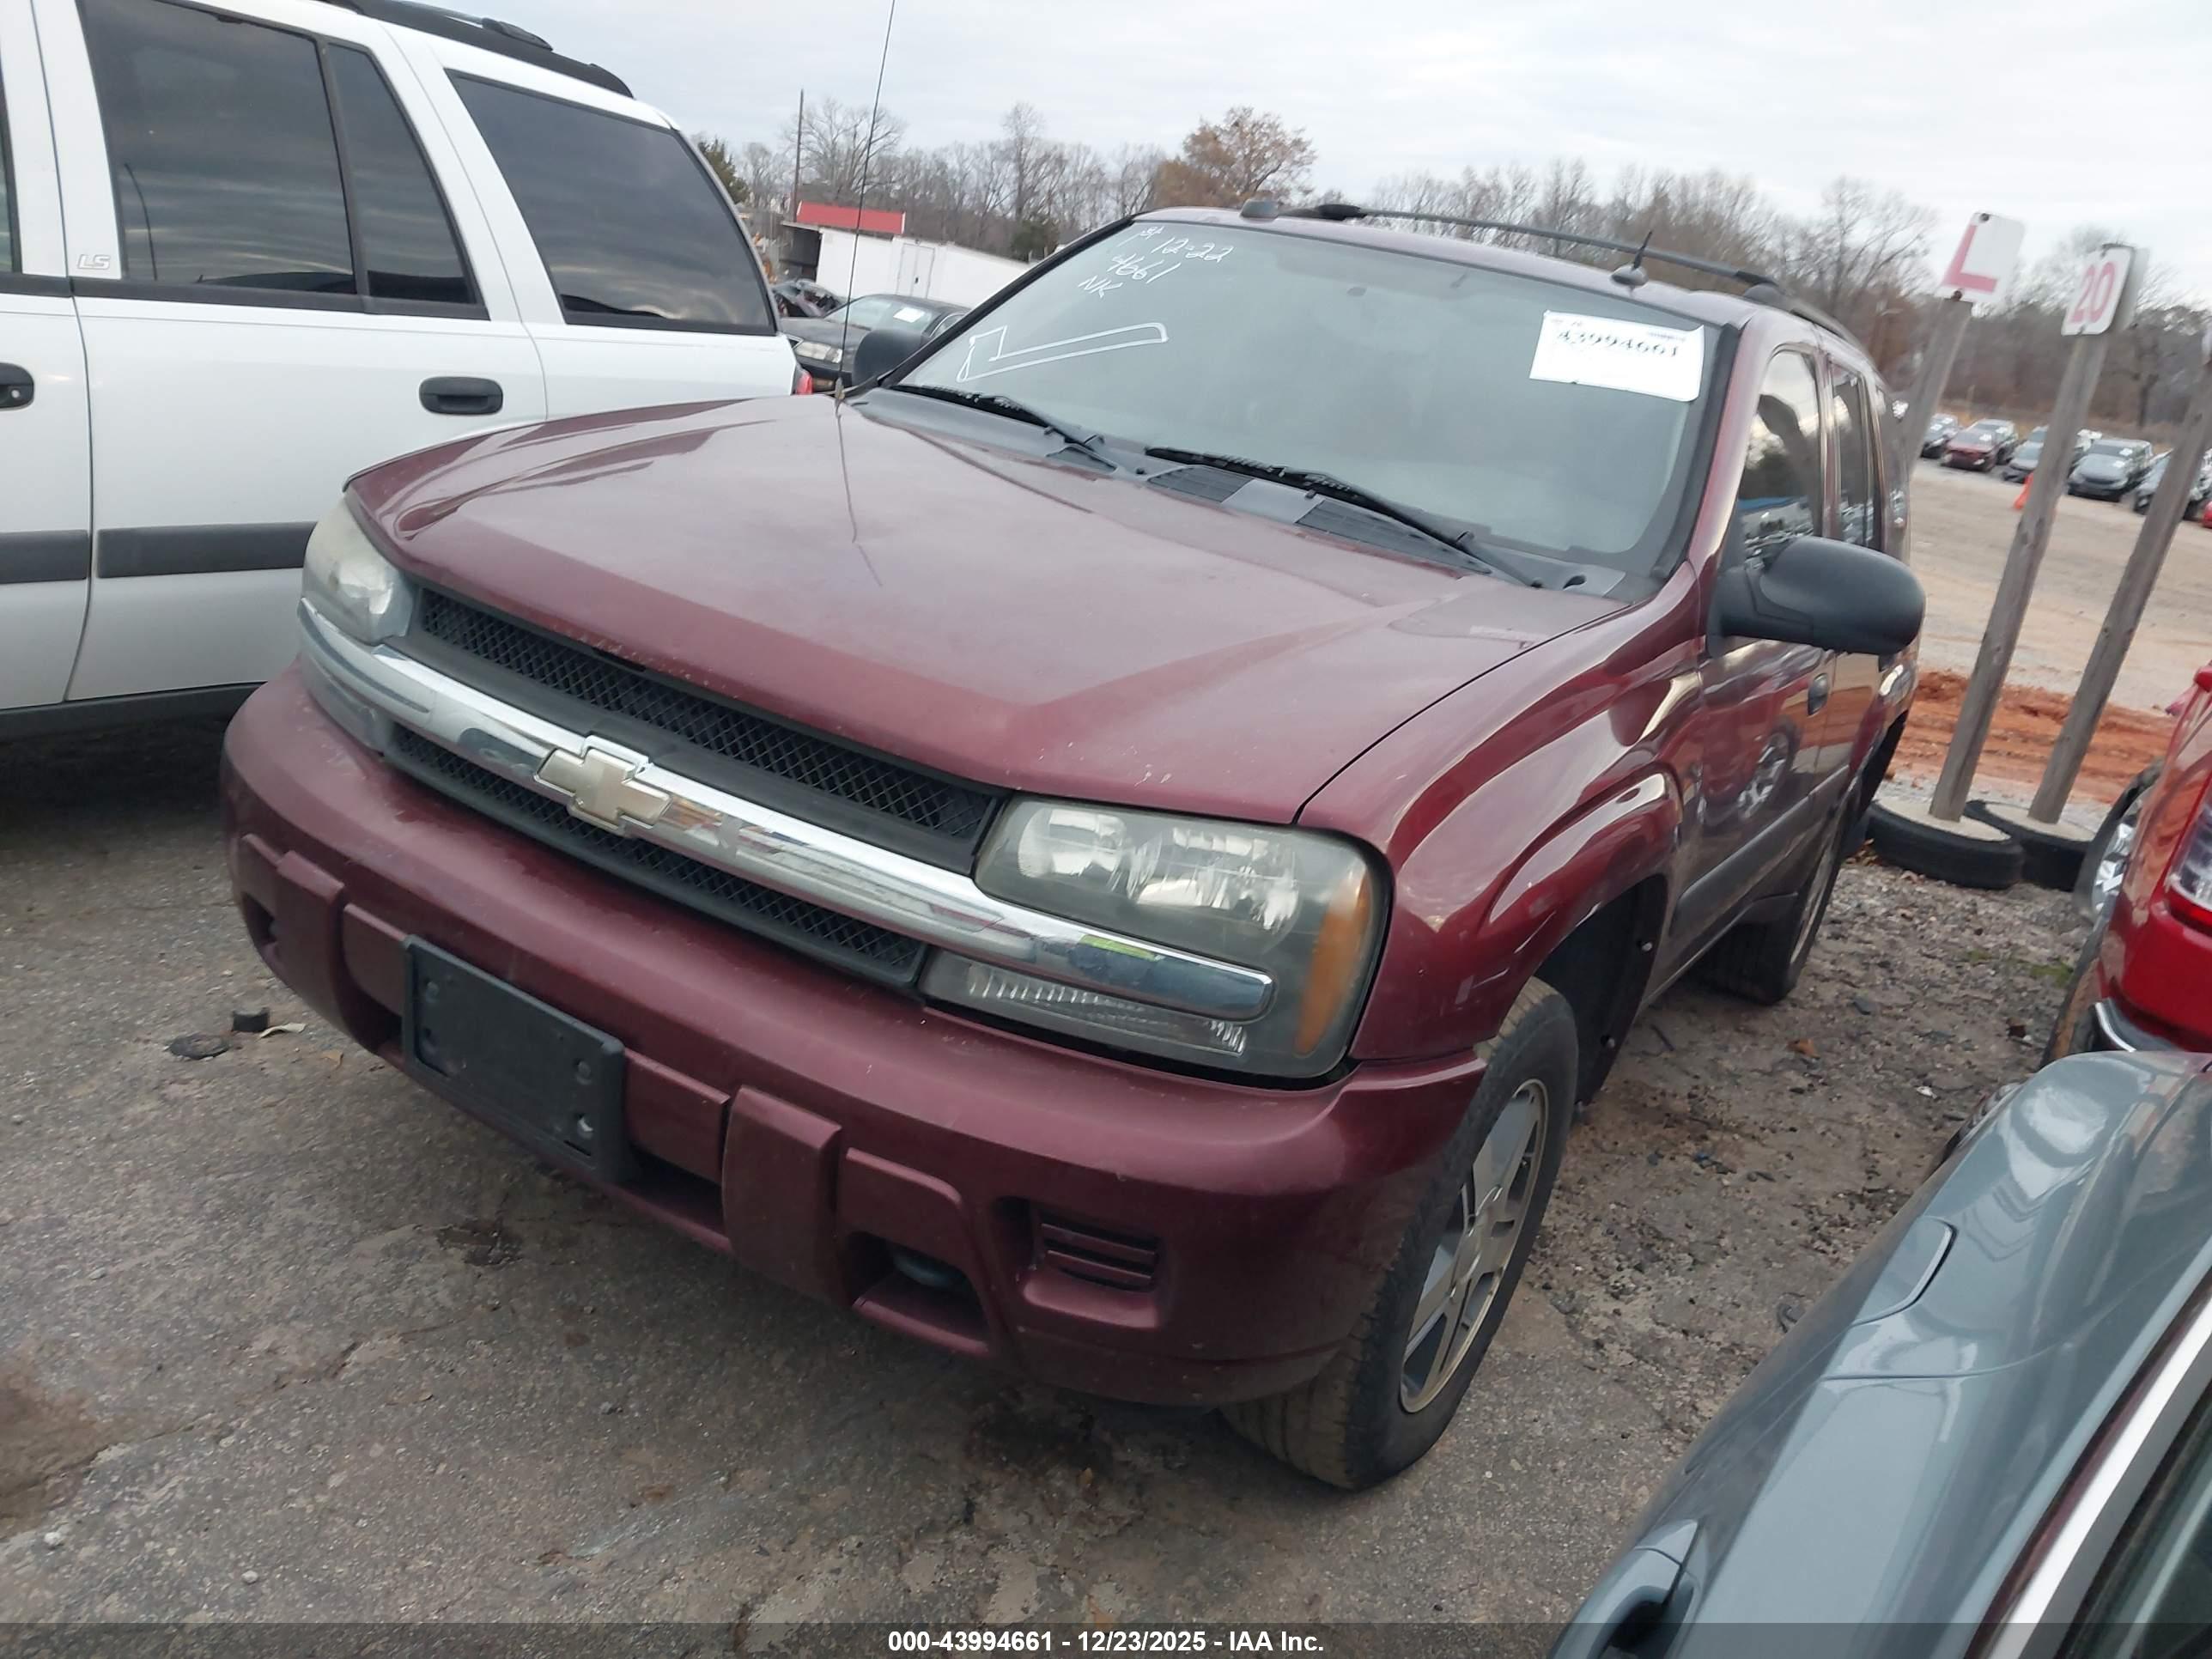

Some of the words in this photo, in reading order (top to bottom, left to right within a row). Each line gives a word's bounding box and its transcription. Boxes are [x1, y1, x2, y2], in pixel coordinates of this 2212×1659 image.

[77, 253, 111, 270] LS
[1151, 237, 1234, 263] 12-22
[1943, 224, 1997, 293] L
[1106, 252, 1182, 284] 4661
[2070, 261, 2116, 323] 20
[1558, 330, 1679, 357] 43994661
